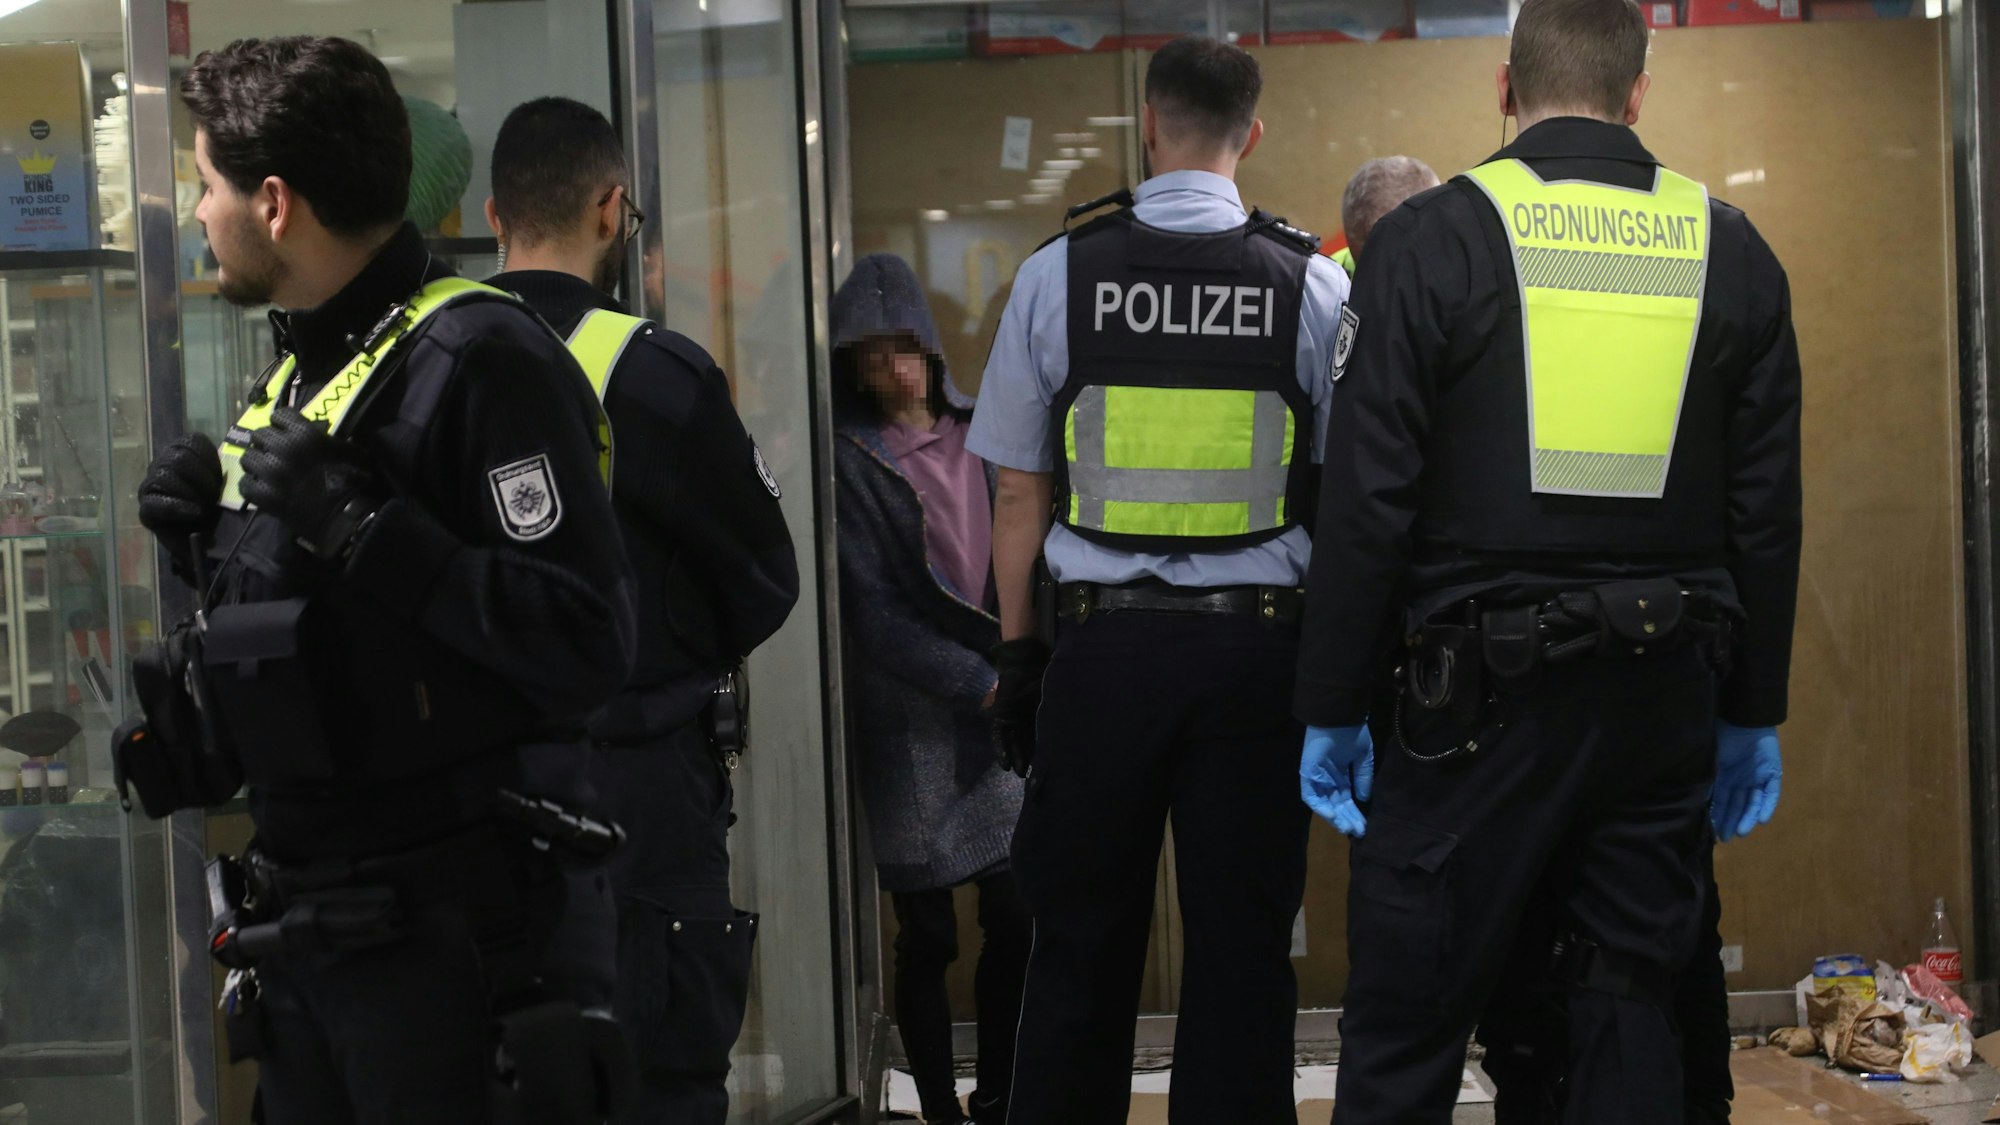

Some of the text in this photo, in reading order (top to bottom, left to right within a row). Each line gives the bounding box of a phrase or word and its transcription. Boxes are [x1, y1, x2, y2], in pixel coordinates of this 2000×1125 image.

[24, 180, 54, 193] KING
[9, 194, 70, 205] TWO SIDED
[21, 206, 62, 216] PUMICE
[1513, 203, 1698, 251] ORDNUNGSAMT
[1095, 281, 1274, 337] POLIZEI
